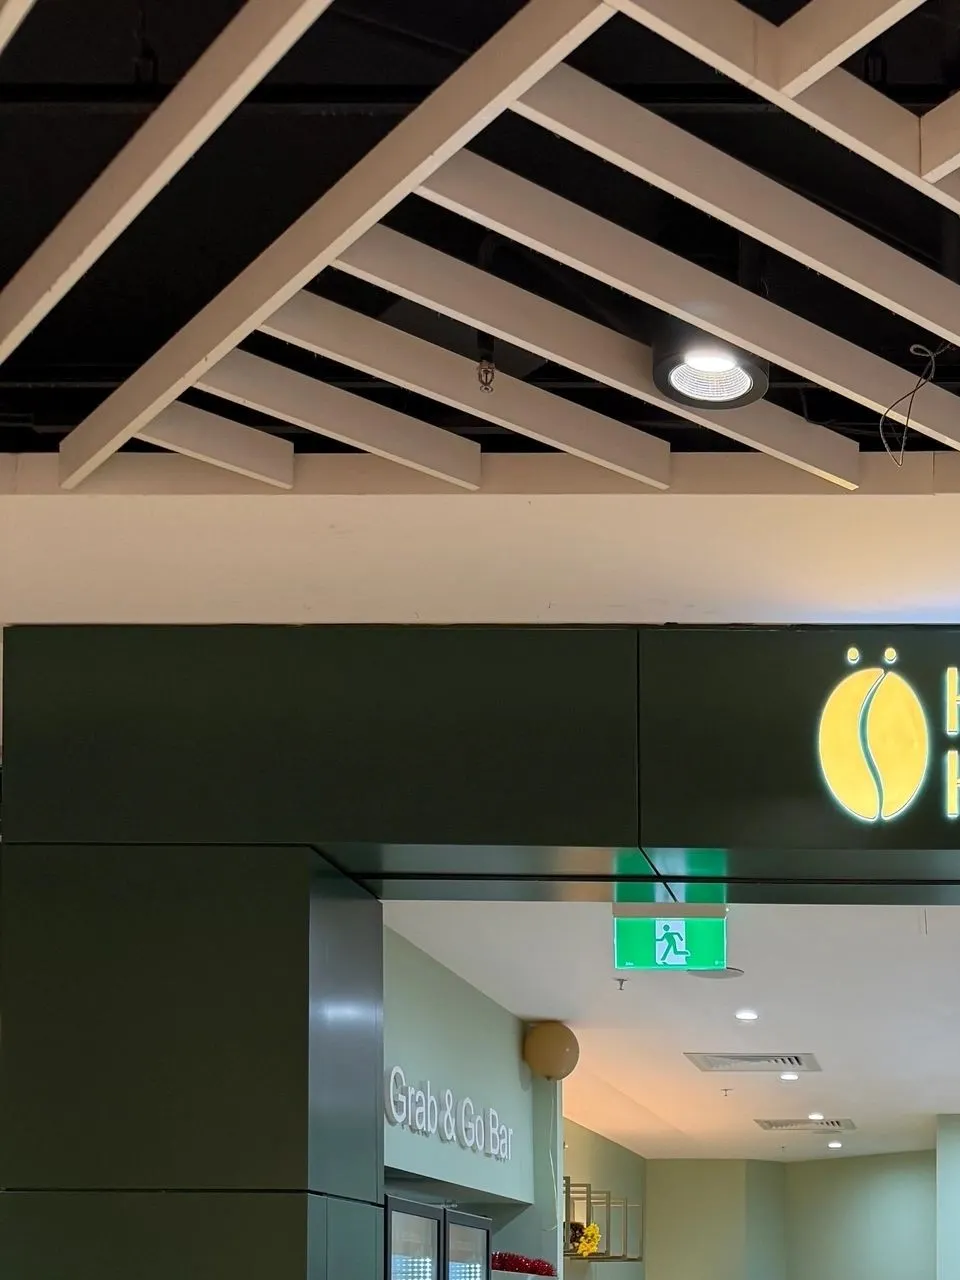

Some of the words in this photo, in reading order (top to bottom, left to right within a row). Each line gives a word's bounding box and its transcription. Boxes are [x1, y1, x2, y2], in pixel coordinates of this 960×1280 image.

[388, 1065, 438, 1134] Grab
[443, 1088, 457, 1142] &
[461, 1096, 485, 1152] Go
[489, 1107, 513, 1161] Bar
